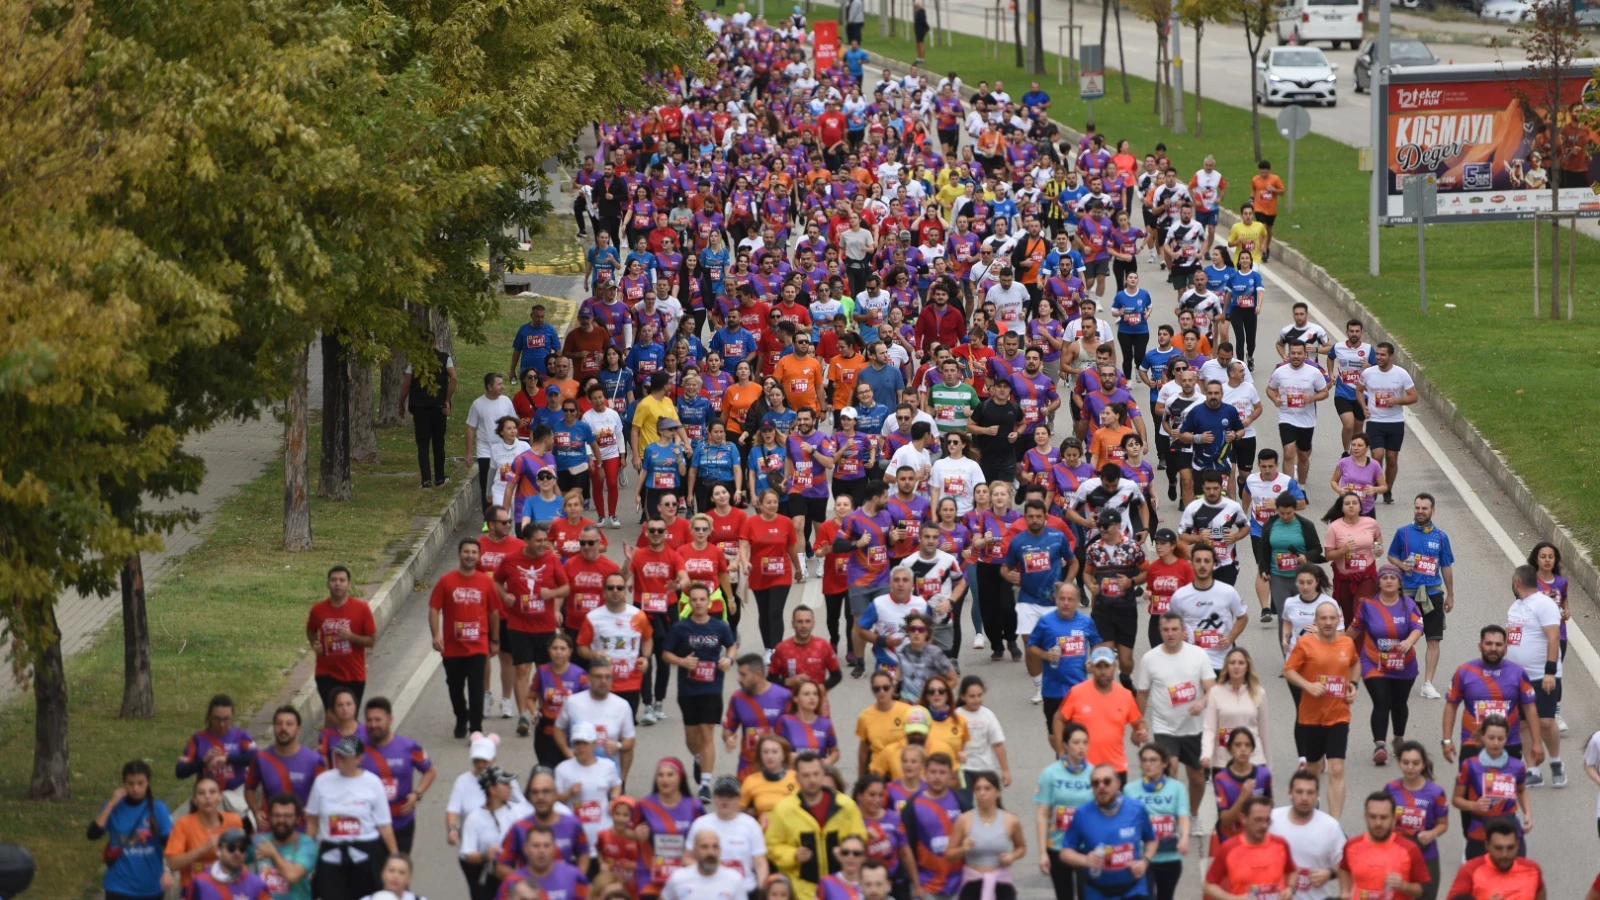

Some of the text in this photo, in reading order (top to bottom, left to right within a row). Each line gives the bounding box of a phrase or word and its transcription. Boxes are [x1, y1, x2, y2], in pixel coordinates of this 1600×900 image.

[1420, 88, 1442, 99] eker
[1396, 114, 1493, 148] KOSMAYA
[1396, 136, 1478, 170] Değer
[1466, 166, 1478, 187] 5
[1032, 557, 1049, 567] 1474
[1418, 560, 1436, 571] 2959
[1153, 576, 1179, 588] Coca-Cola
[689, 635, 718, 644] BOSS
[1139, 795, 1172, 805] EGV
